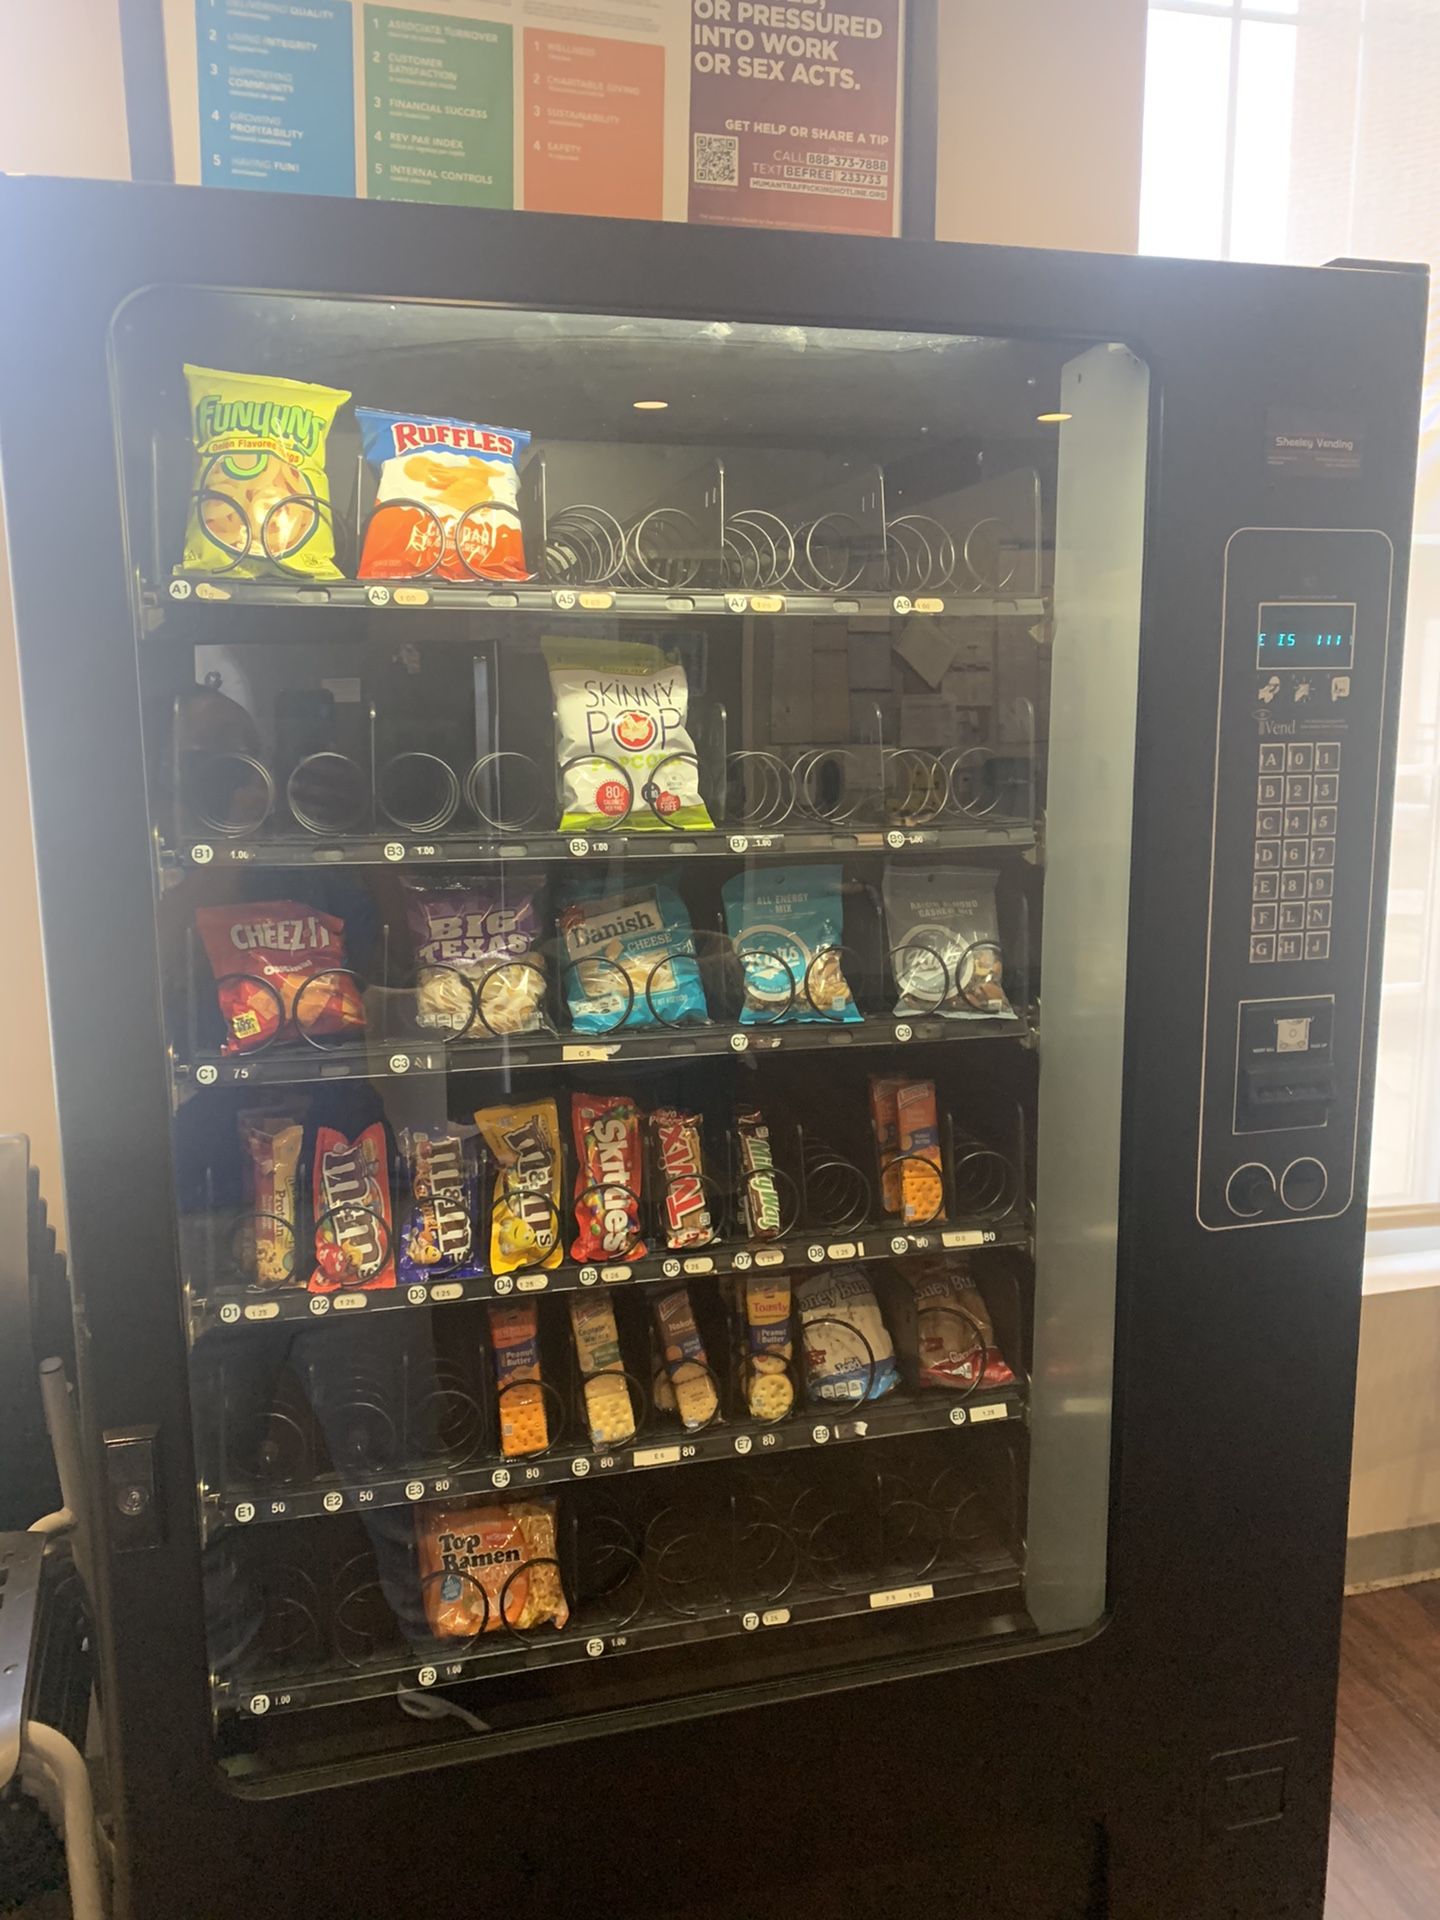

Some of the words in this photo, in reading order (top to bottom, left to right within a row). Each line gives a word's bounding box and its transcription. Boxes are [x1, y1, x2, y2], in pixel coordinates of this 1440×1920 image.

[693, 0, 732, 21] OR
[736, 2, 884, 40] PRESSURED
[208, 28, 217, 42] 2
[694, 23, 755, 51] INTO
[760, 31, 840, 62] WORK
[372, 51, 381, 64] 2
[209, 63, 219, 76] 3
[694, 51, 732, 75] OR
[736, 55, 786, 83] SEX
[790, 62, 862, 91] ACTS.
[532, 73, 541, 85] 2
[211, 108, 221, 122] 4
[373, 96, 382, 109] 3
[389, 98, 442, 115] FINANCIAL
[444, 105, 489, 121] SUCCESS
[532, 105, 541, 118] 3
[229, 122, 305, 140] PROFITABILITY
[724, 119, 751, 133] GET
[753, 122, 787, 137] HELP
[789, 125, 809, 139] OR
[810, 128, 854, 143] SHARE
[856, 131, 867, 145] A
[869, 132, 890, 147] TIP
[374, 130, 383, 143] 4
[389, 131, 409, 143] REV
[411, 134, 431, 146] PAR
[432, 137, 465, 151] INDEX
[532, 140, 541, 152] 4
[212, 153, 223, 167] 5
[772, 149, 805, 164] CALL
[374, 162, 383, 175] 5
[389, 164, 439, 179] INTERNAL
[440, 170, 494, 186] CONTROLS
[751, 161, 782, 177] TEXT
[785, 166, 833, 181] BEFREE
[839, 170, 883, 186] 233733
[392, 422, 515, 456] RUFFLES
[1316, 438, 1354, 451] Vending
[171, 584, 189, 597] A1
[370, 591, 388, 602] A3
[558, 594, 574, 605] A5
[730, 598, 745, 609] A7
[895, 599, 910, 611] A9
[1278, 633, 1296, 646] IS
[584, 680, 675, 708] SKINNY
[586, 707, 683, 753] POP
[1265, 753, 1277, 766] A
[1265, 785, 1276, 798] B
[1293, 785, 1302, 797] 2
[1320, 784, 1330, 796] 3
[1262, 817, 1273, 830] C
[1291, 816, 1300, 829] 4
[1319, 815, 1328, 828] 5
[731, 838, 746, 848] B7
[889, 833, 903, 844] B9
[387, 845, 404, 856] B3
[571, 841, 588, 852] B5
[592, 842, 609, 852] 1.00
[194, 849, 211, 860] B1
[1262, 848, 1273, 861] D
[1290, 848, 1298, 860] 6
[1317, 847, 1326, 859] 7
[1260, 880, 1271, 893] E
[1288, 880, 1297, 892] 8
[1316, 879, 1324, 890] 9
[757, 895, 772, 905] ALL
[775, 903, 792, 912] MIX
[1259, 911, 1269, 925] F
[1286, 910, 1295, 923] L
[1313, 909, 1324, 922] N
[429, 910, 517, 940] BIG
[571, 910, 655, 949] Danish
[627, 932, 673, 951] CHEESE
[1256, 943, 1267, 956] G
[1284, 941, 1295, 954] H
[1311, 940, 1320, 953] J
[419, 933, 530, 964] TEXAS
[897, 1027, 911, 1038] C9
[732, 1035, 747, 1048] C7
[391, 1055, 409, 1068] C3
[198, 1068, 215, 1080] C1
[232, 1068, 249, 1080] 75
[658, 1123, 706, 1230] TWIX
[983, 1232, 996, 1242] 80
[892, 1240, 908, 1250] D9
[809, 1248, 825, 1259] D8
[664, 1260, 680, 1272] D6
[736, 1255, 751, 1266] D7
[581, 1270, 597, 1281] D5
[496, 1278, 512, 1290] D4
[409, 1288, 426, 1300] D3
[312, 1298, 329, 1310] D2
[753, 1302, 789, 1314] Toasty
[222, 1307, 239, 1319] D1
[505, 1349, 535, 1360] Peanut
[506, 1357, 532, 1367] Butter
[951, 1410, 966, 1421] E0
[814, 1428, 829, 1439] E9
[736, 1438, 751, 1449] E7
[762, 1434, 776, 1446] 80
[682, 1446, 696, 1457] 80
[573, 1461, 589, 1473] E5
[600, 1458, 614, 1469] 80
[493, 1472, 509, 1484] E4
[525, 1468, 540, 1480] 80
[407, 1483, 423, 1496] E3
[435, 1480, 450, 1492] 80
[325, 1494, 341, 1506] E2
[359, 1490, 374, 1502] 50
[237, 1505, 254, 1518] E1
[271, 1502, 286, 1514] 50
[438, 1533, 481, 1553] Top
[441, 1547, 521, 1570] Ramen
[744, 1616, 758, 1627] F7
[588, 1640, 603, 1652] F5
[611, 1636, 627, 1648] 1.00
[420, 1669, 436, 1681] F3
[445, 1664, 462, 1675] 1.00
[252, 1698, 268, 1711] F1
[274, 1694, 291, 1706] 1.00
